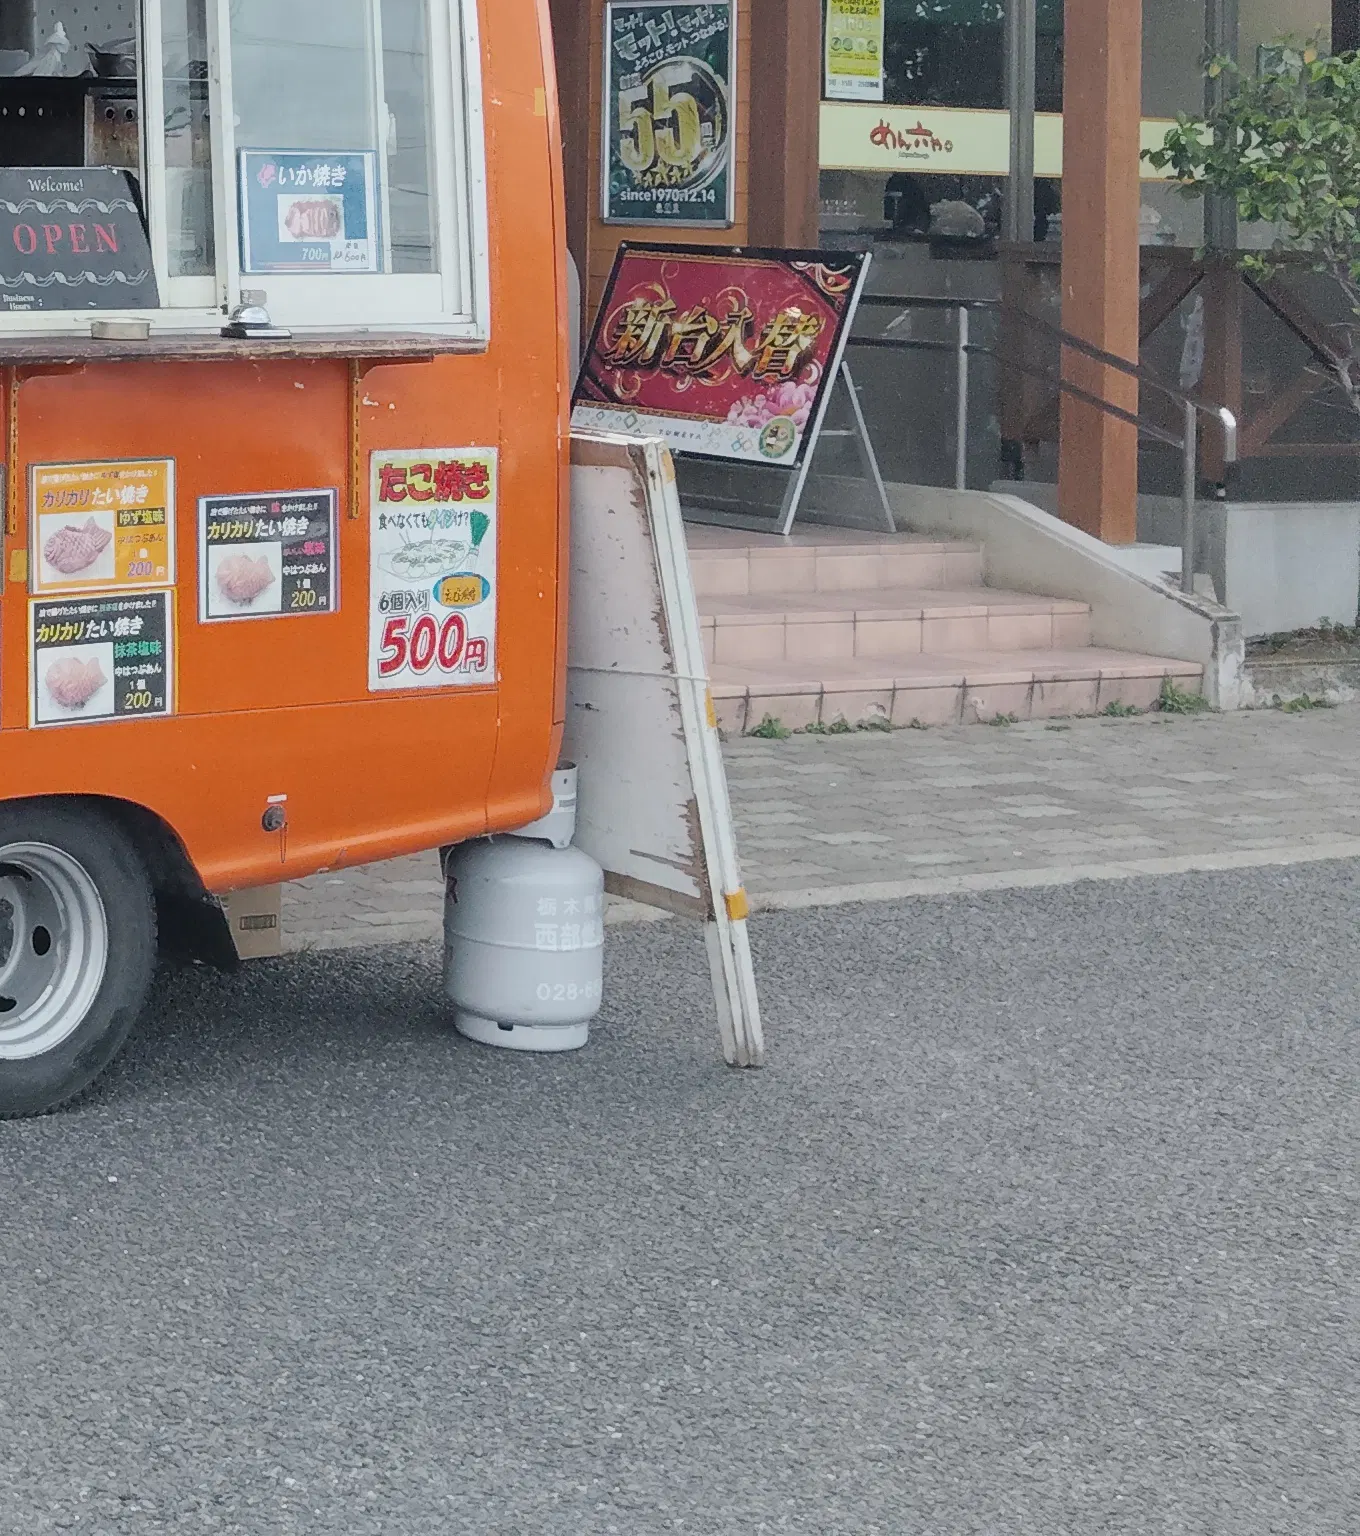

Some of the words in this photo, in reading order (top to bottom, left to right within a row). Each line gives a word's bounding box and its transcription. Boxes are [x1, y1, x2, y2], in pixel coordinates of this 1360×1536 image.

[28, 176, 84, 192] Welcome!
[278, 164, 347, 186] いか焼き
[13, 223, 119, 254] OPEN
[605, 299, 820, 380] 新台入替
[378, 460, 491, 502] たこ焼き
[41, 483, 149, 508] カリカリたい焼き
[207, 516, 310, 540] カリカリたい焼き
[379, 590, 429, 613] 6個入り
[36, 615, 144, 643] カリカリたい焼き
[377, 613, 488, 677] 500円
